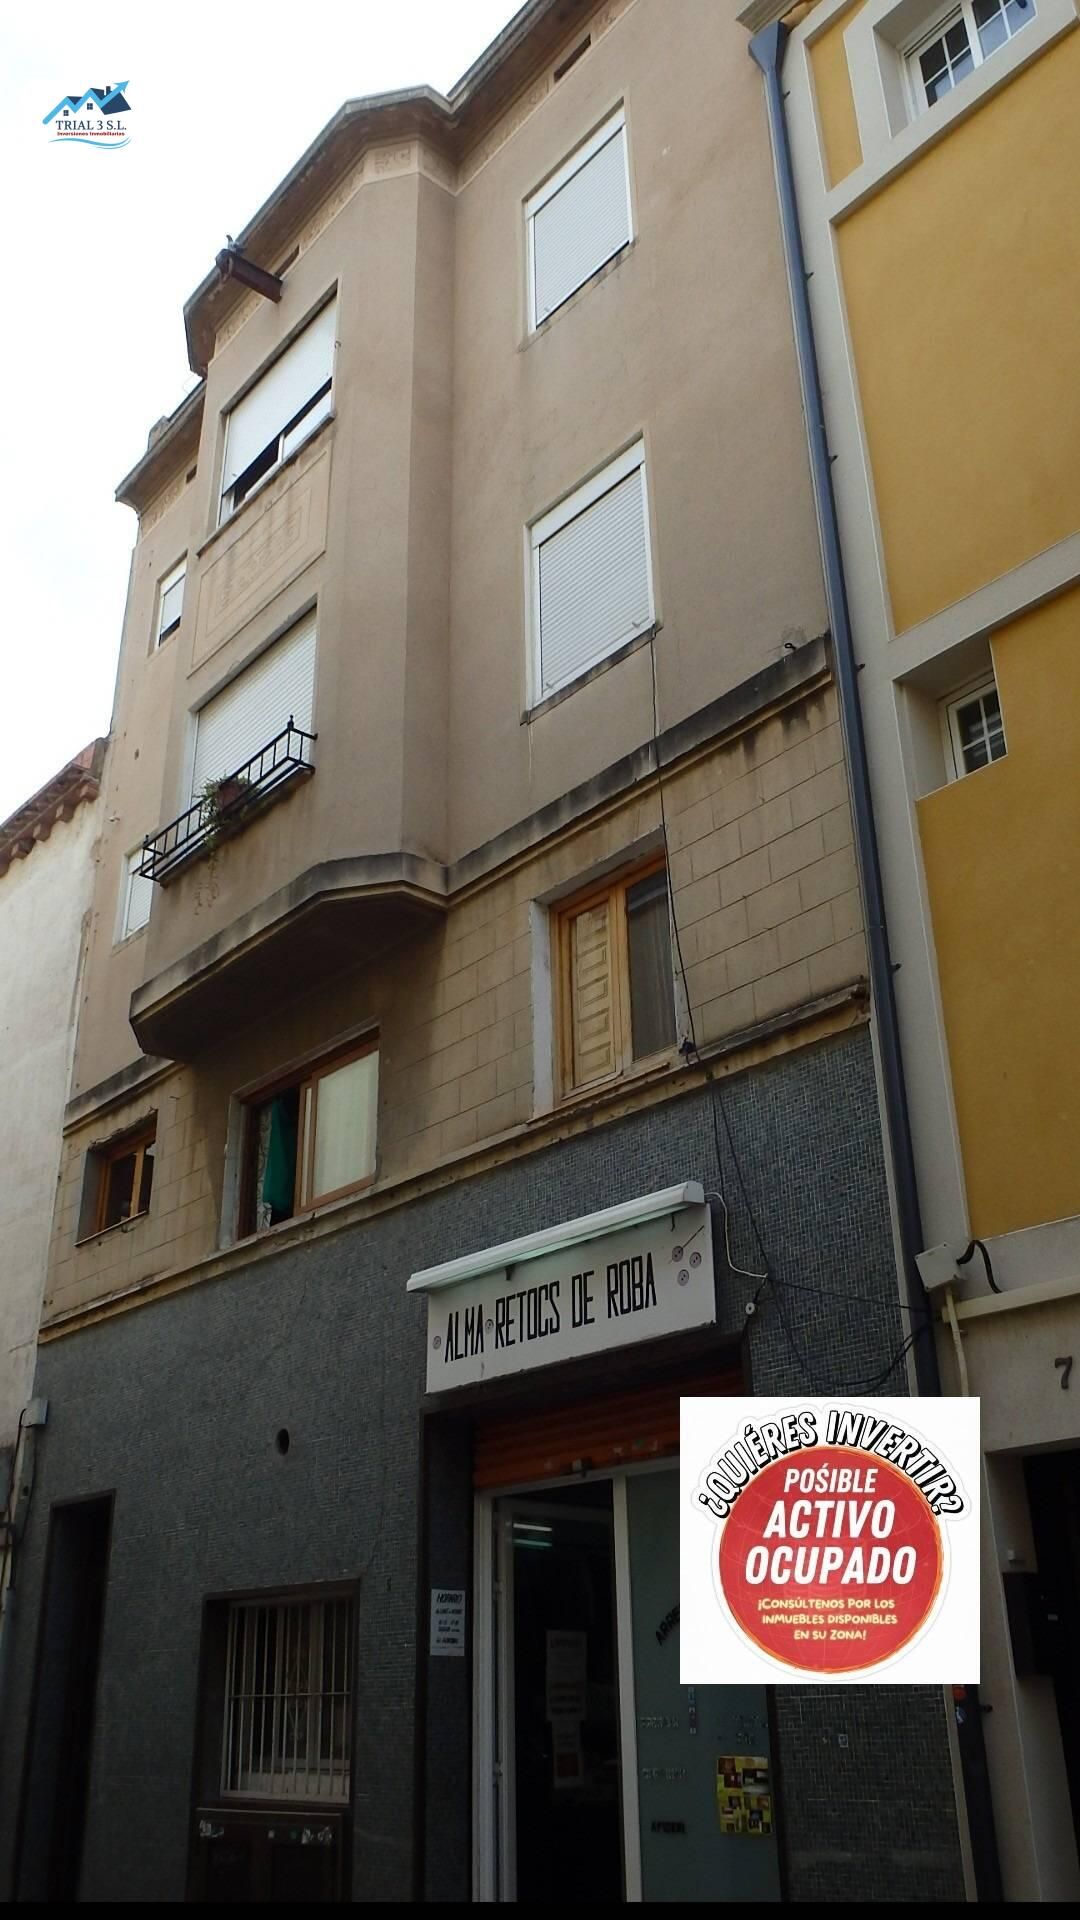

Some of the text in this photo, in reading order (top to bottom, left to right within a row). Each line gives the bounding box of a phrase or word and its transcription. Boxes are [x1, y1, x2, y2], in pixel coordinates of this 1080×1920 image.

[444, 1251, 658, 1363] ALMA RETOCS DE ROBA
[1054, 1355, 1073, 1390] 7
[655, 1602, 680, 1647] ARRE
